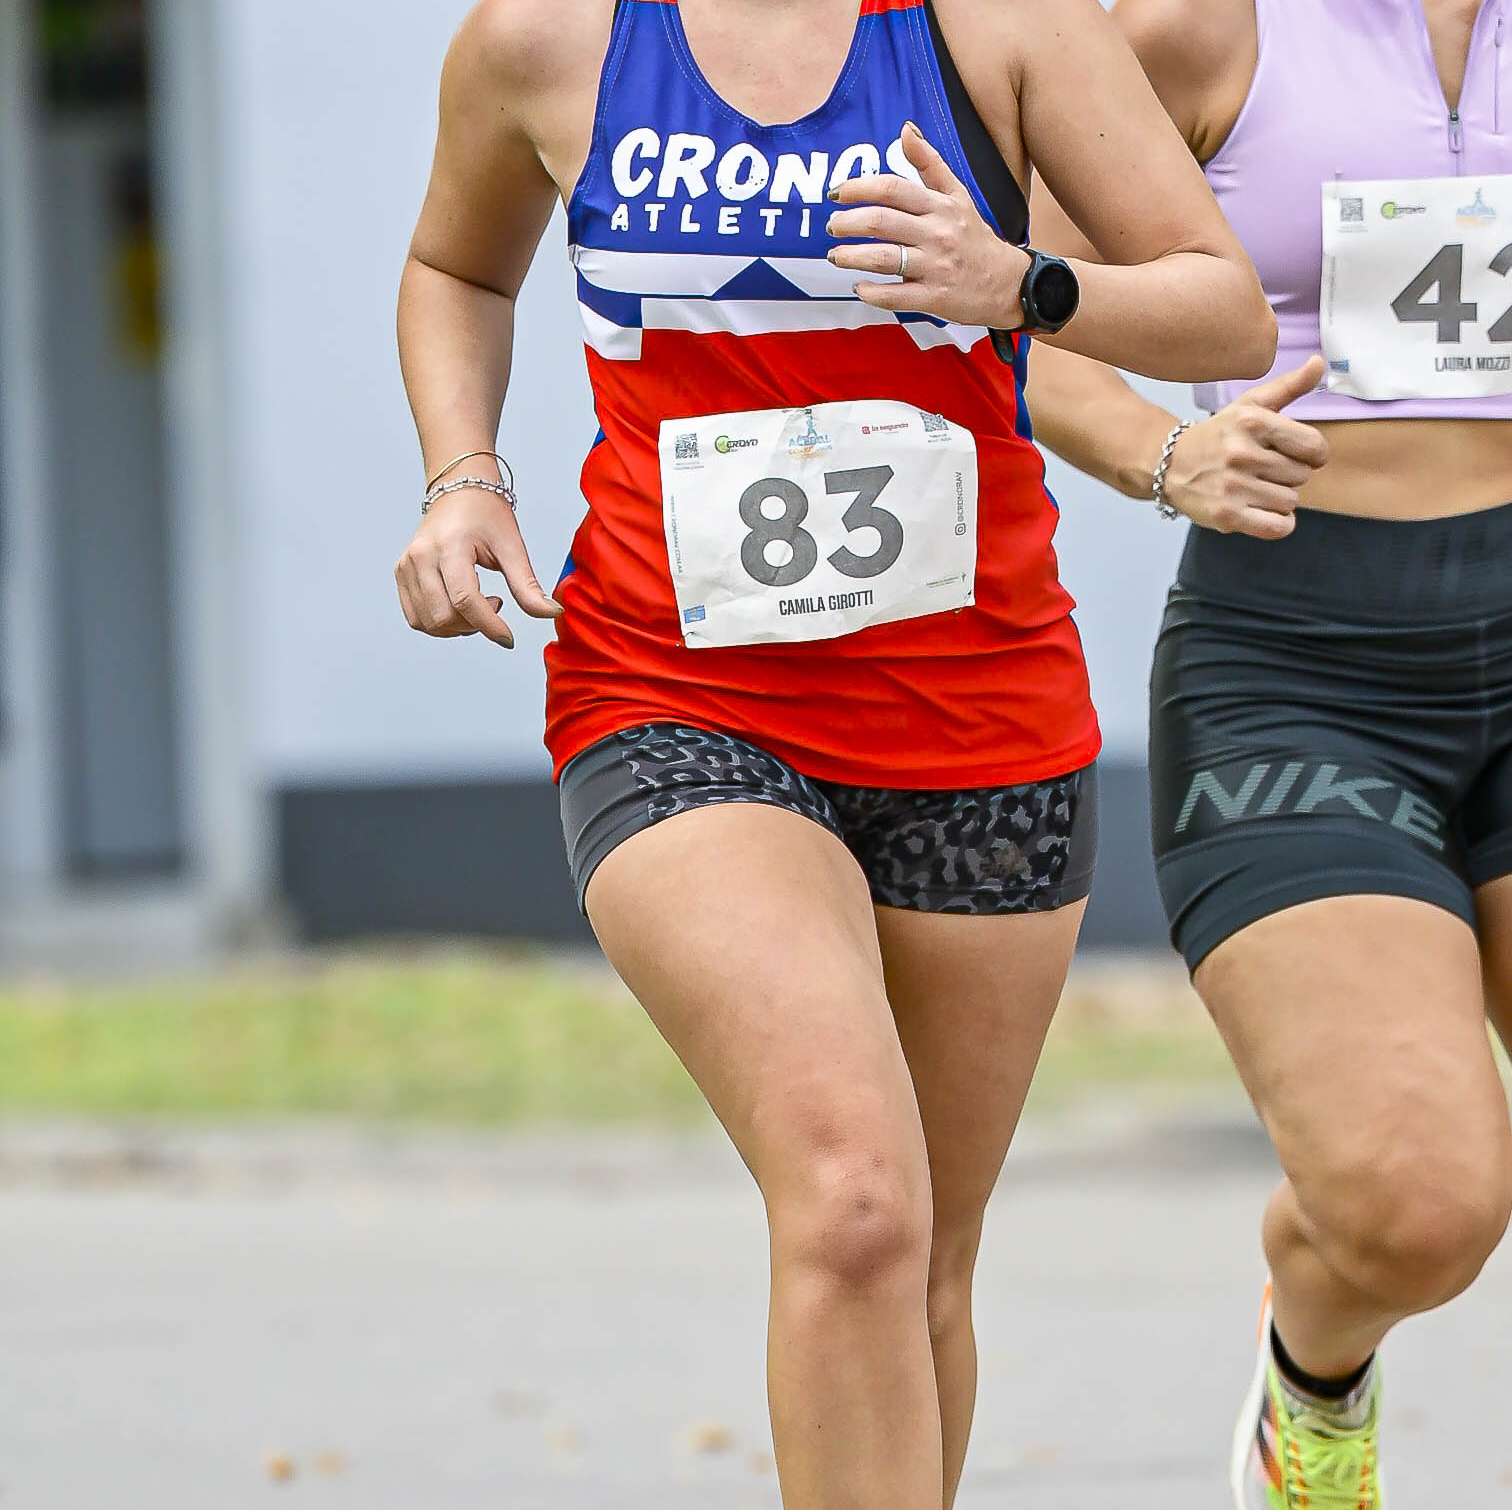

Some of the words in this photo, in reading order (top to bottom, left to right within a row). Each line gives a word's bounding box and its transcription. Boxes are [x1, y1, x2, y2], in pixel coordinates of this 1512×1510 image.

[611, 203, 845, 238] ATLETI
[1435, 356, 1471, 372] LAURA
[738, 464, 904, 587] 83
[778, 596, 826, 616] CAMILA
[828, 589, 874, 611] GIROTTI
[1174, 761, 1446, 851] NIKE
